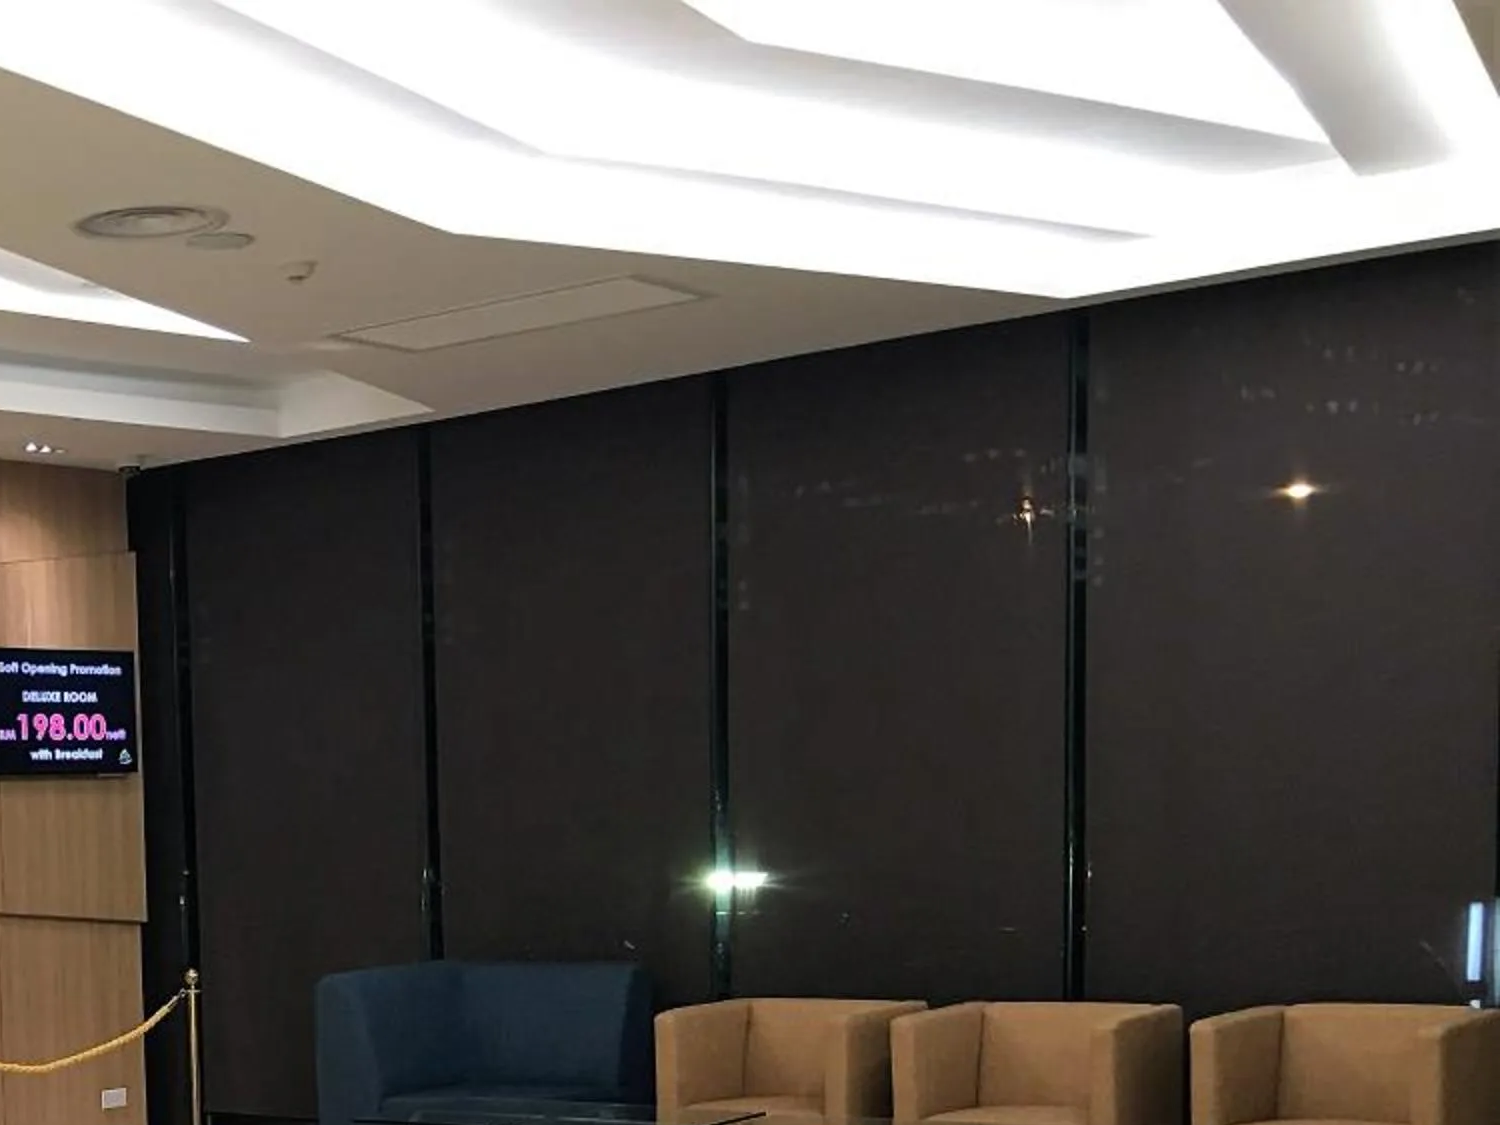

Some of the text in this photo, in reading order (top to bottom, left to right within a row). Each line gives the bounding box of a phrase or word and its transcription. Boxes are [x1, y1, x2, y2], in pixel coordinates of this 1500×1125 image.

[21, 662, 68, 676] Opening
[70, 664, 122, 675] Promotion
[22, 690, 98, 702] DELUXE ROOM
[17, 713, 106, 740] 198.00
[30, 749, 103, 760] with Breakfast
